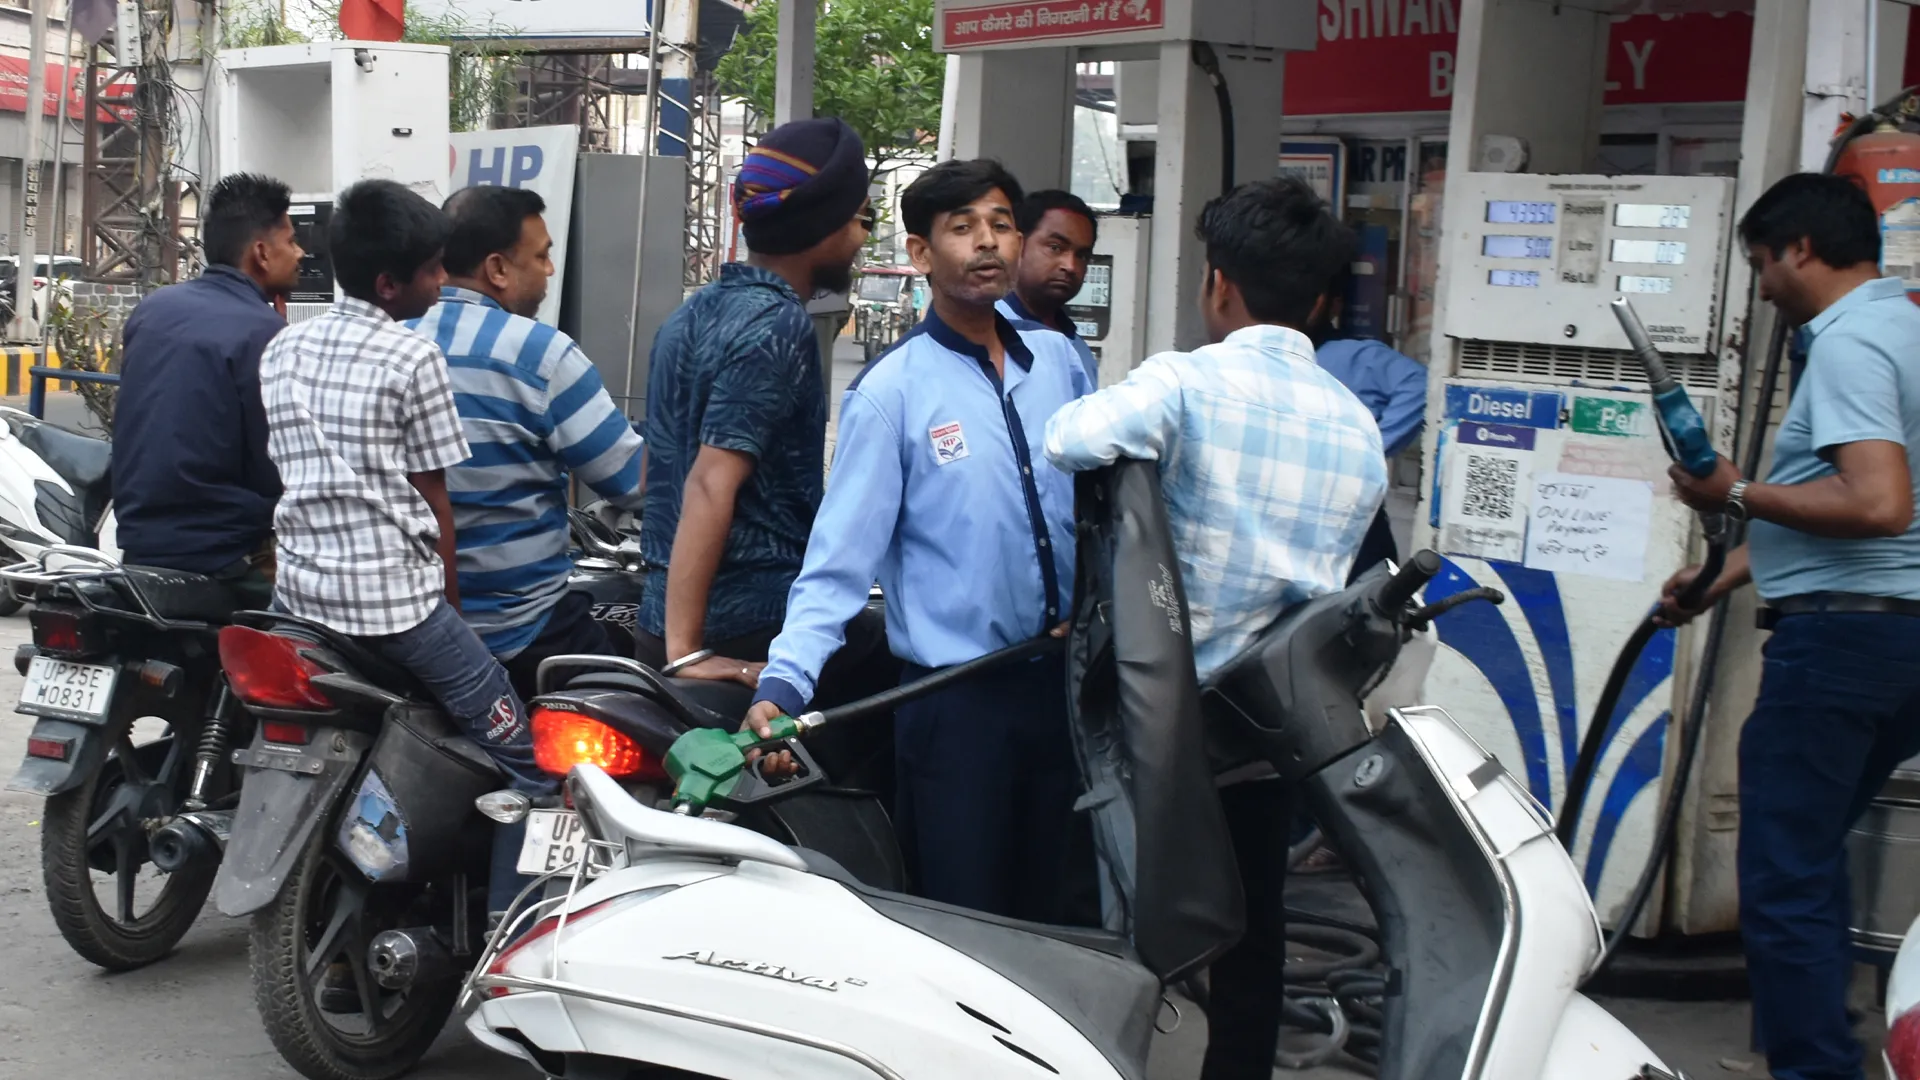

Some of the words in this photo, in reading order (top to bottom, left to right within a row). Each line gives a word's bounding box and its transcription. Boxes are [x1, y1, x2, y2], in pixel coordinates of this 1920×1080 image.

[954, 20, 979, 36] आप
[1015, 9, 1034, 29] की
[467, 145, 544, 189] HP
[1563, 203, 1605, 217] Rupees
[1468, 394, 1532, 420] Diesel
[43, 661, 103, 689] UP25E
[661, 950, 838, 992] Activa
